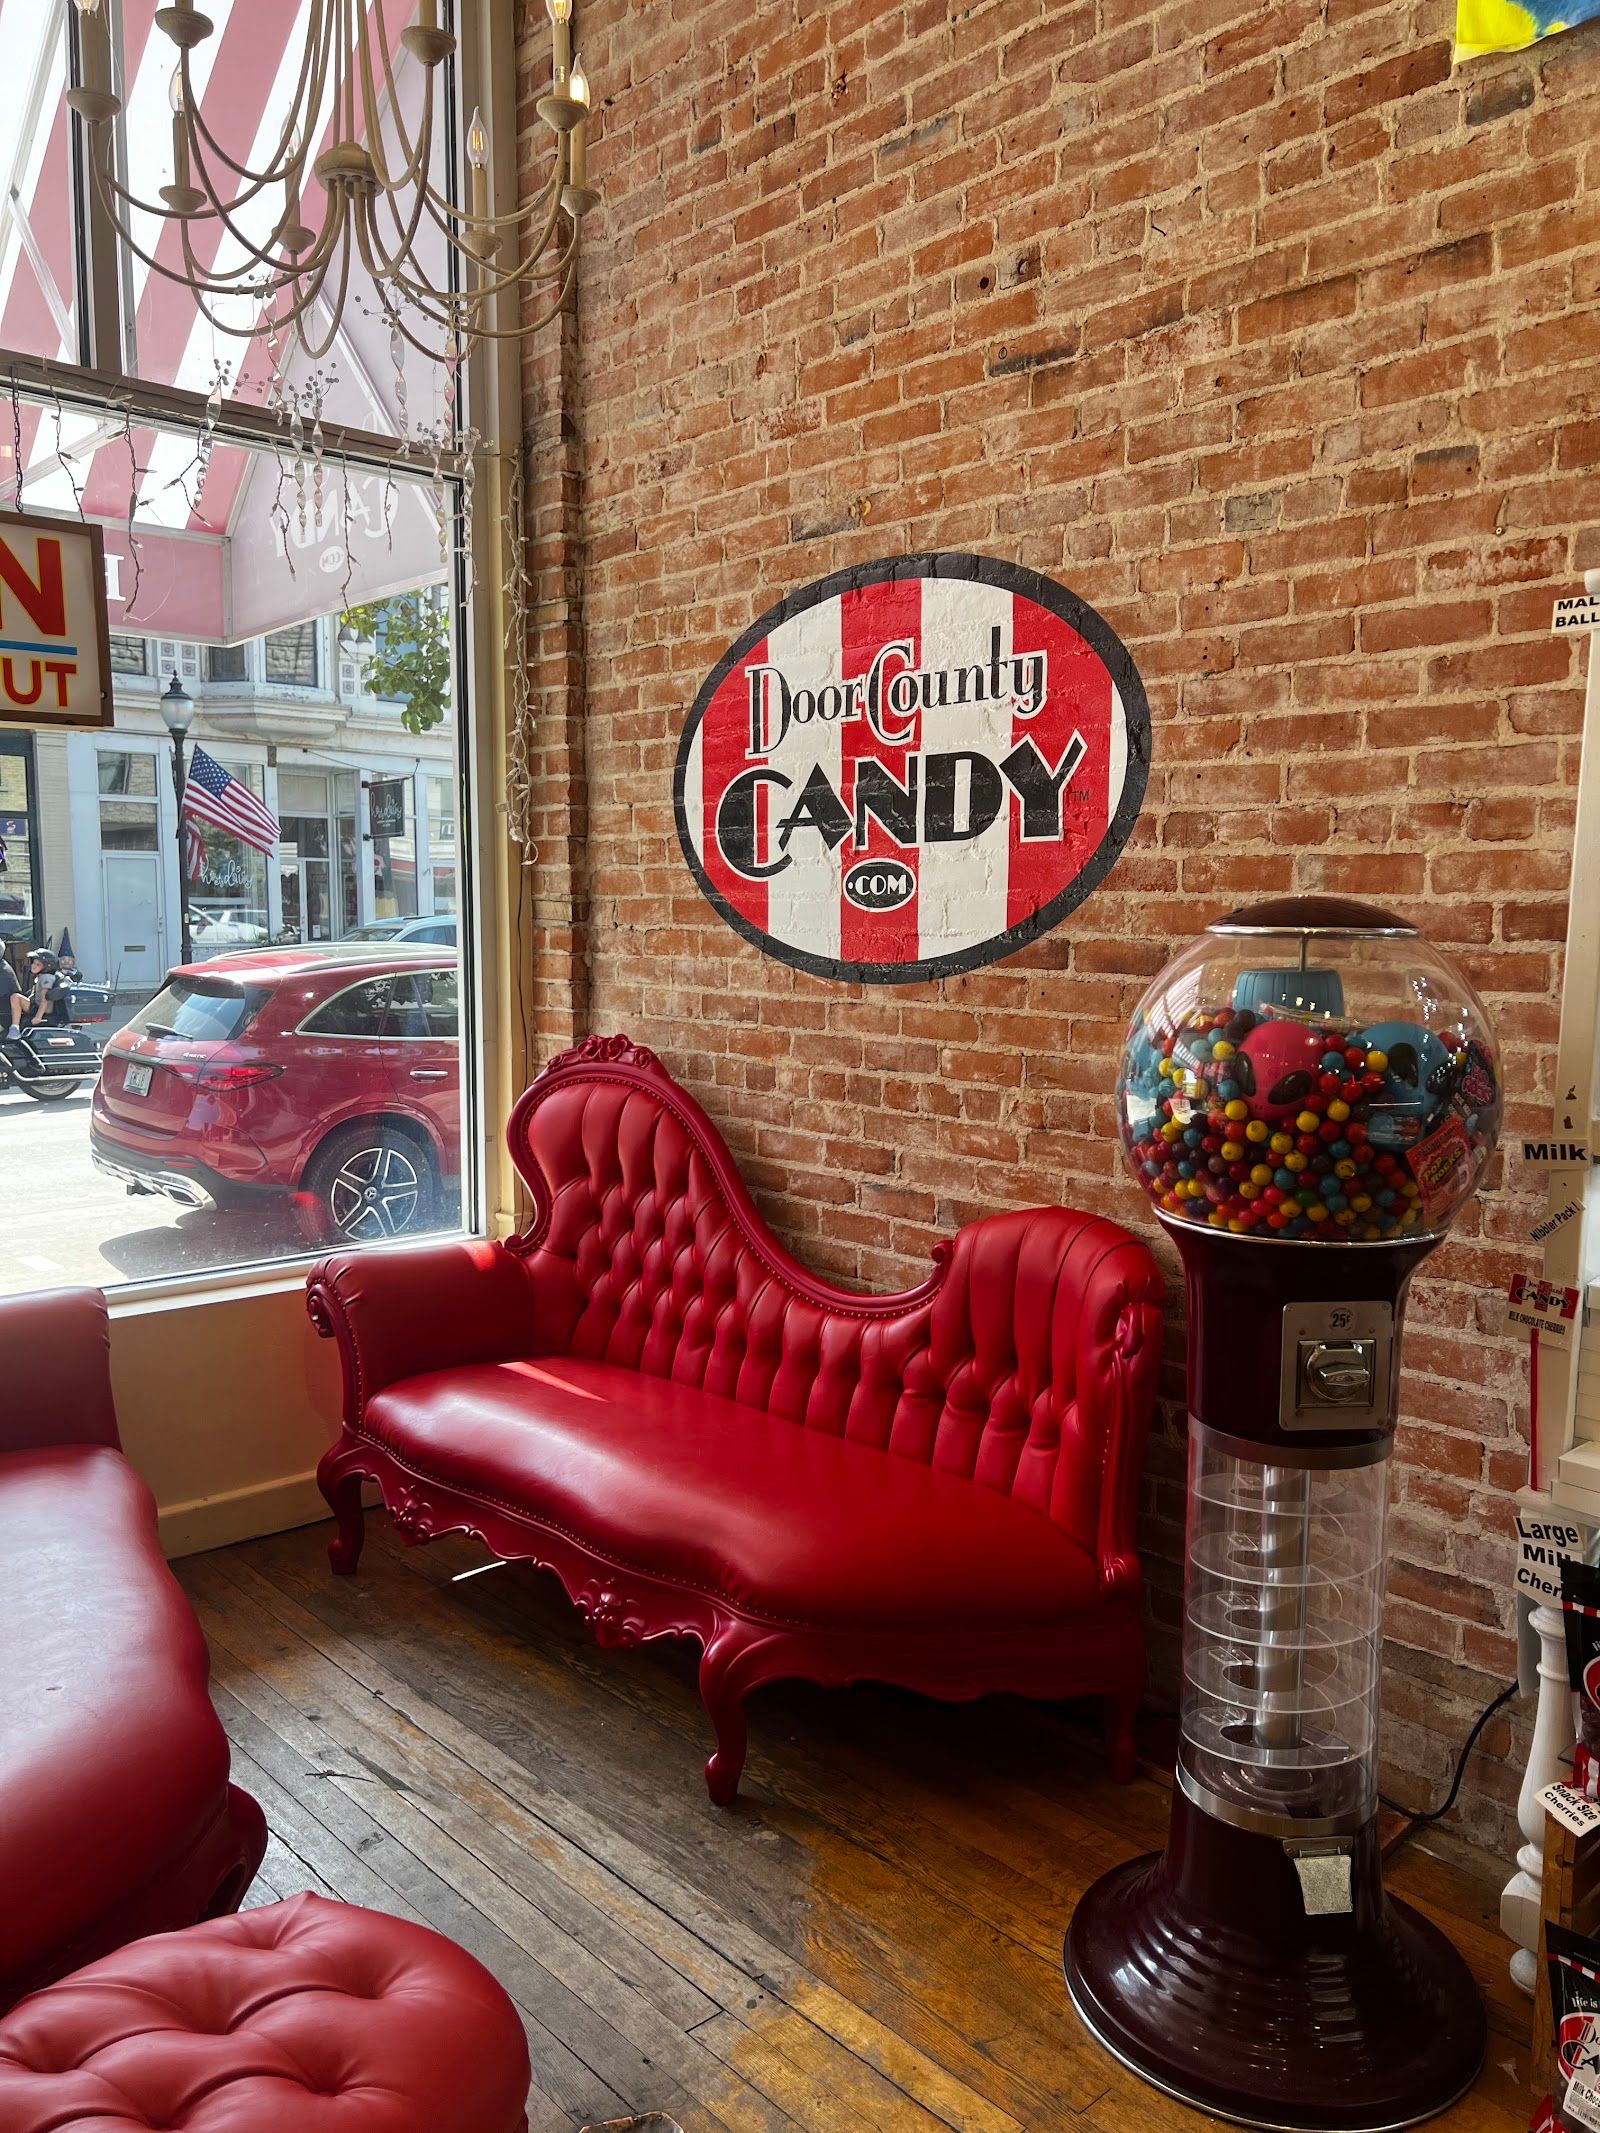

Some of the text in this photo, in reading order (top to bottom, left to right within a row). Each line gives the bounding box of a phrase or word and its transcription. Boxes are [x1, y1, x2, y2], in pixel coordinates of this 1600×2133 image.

[745, 626, 1046, 757] Door County
[716, 732, 1086, 879] CANDY
[1523, 1144, 1588, 1161] Milk
[1530, 1219, 1558, 1242] Nibbler
[1554, 1204, 1577, 1224] Pack
[1515, 1287, 1568, 1309] CANDY
[1515, 1517, 1579, 1547] Large
[1544, 1791, 1585, 1827] Cherries
[1552, 1784, 1598, 1820] Snack Size
